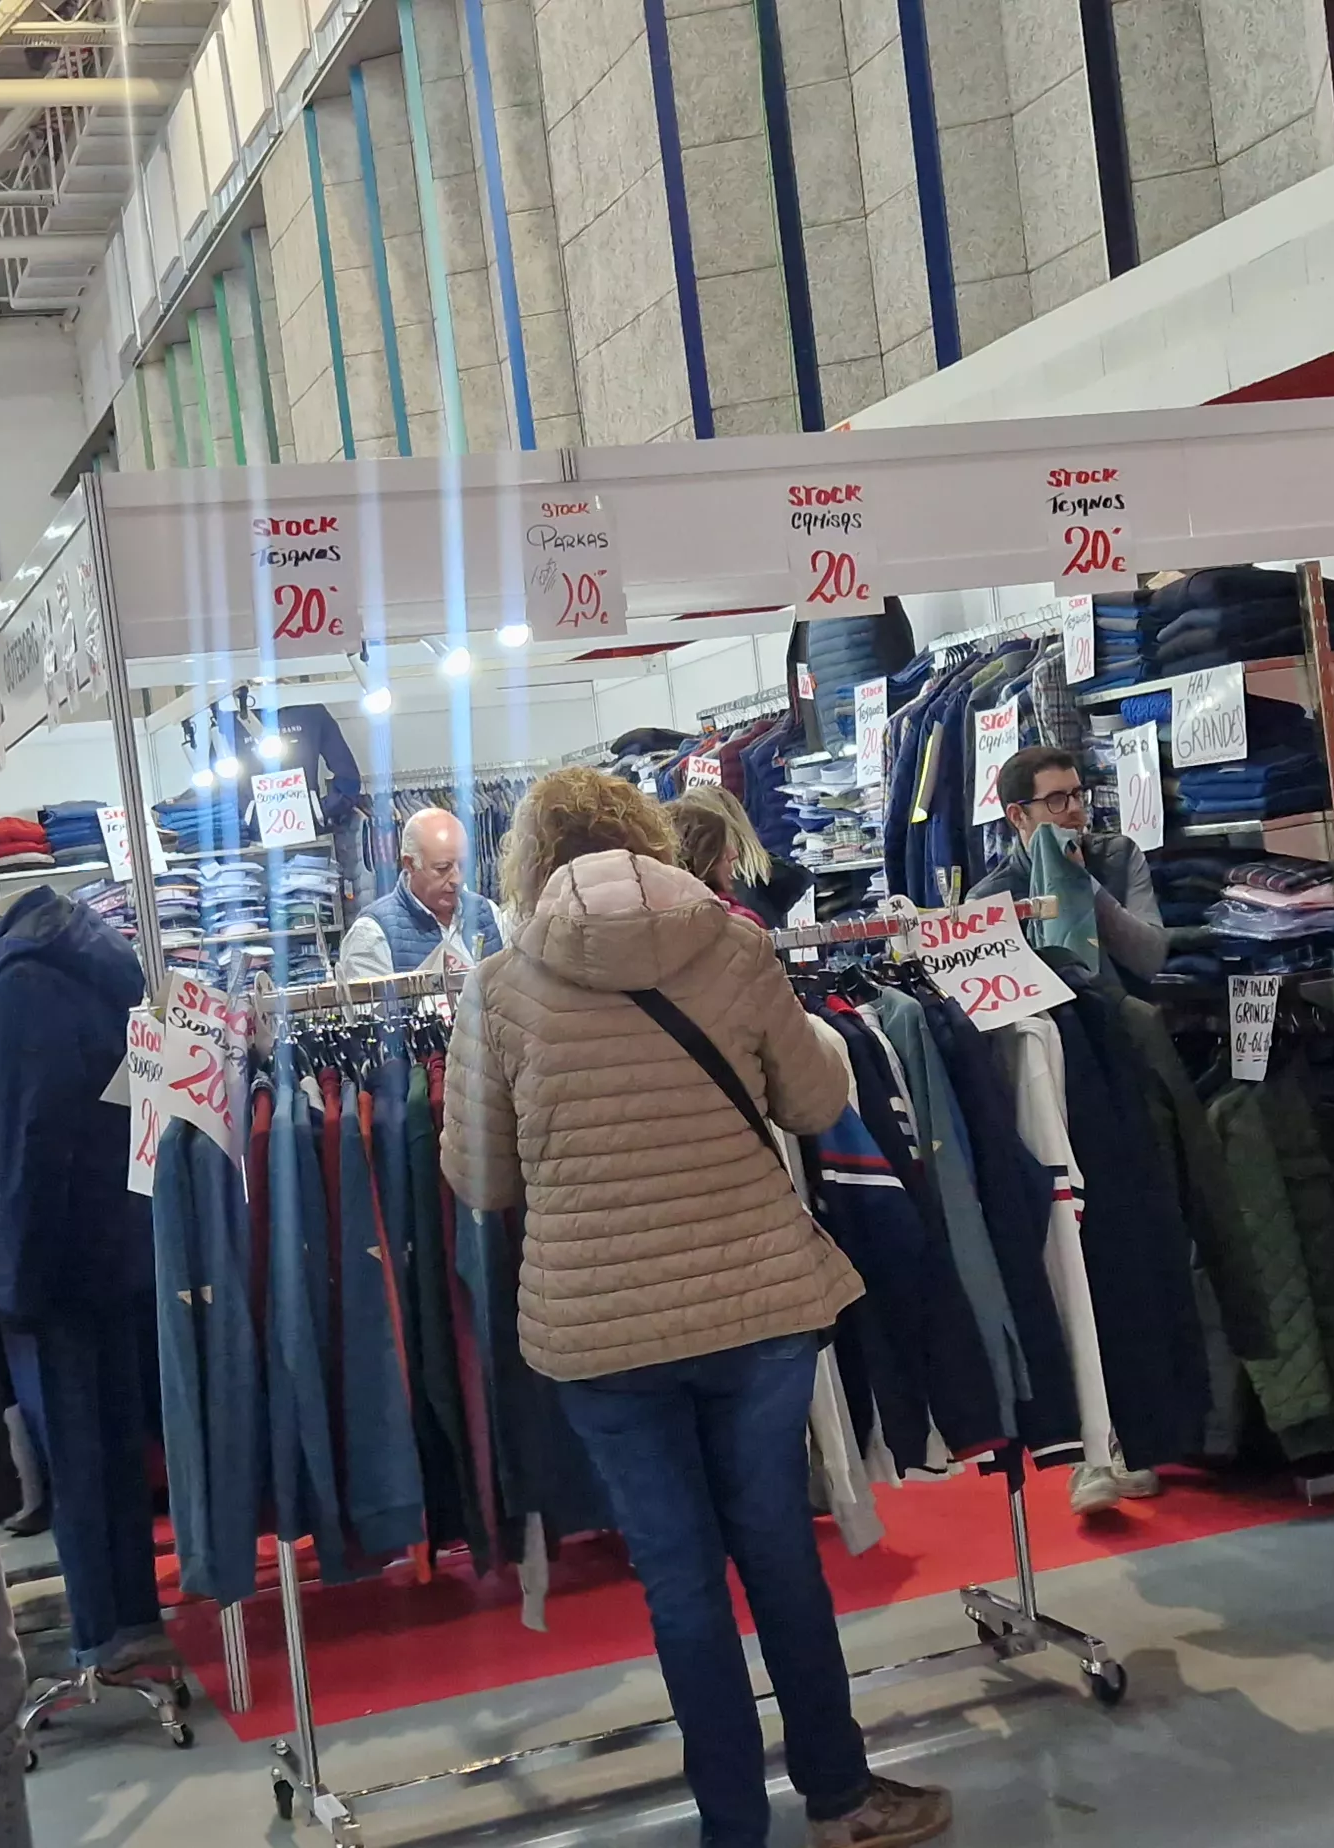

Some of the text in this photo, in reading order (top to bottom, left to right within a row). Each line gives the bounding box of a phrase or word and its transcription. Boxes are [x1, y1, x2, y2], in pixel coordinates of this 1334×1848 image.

[1046, 468, 1119, 488] STOCK
[787, 484, 863, 507] STOCK
[541, 502, 590, 518] STOCK
[253, 516, 339, 537] STOCK
[527, 524, 609, 552] PARKAS
[1187, 671, 1213, 696] HAY
[1176, 705, 1245, 759] GRANDES
[921, 905, 1007, 948] STOCK
[922, 938, 1021, 975] SUDADERAS
